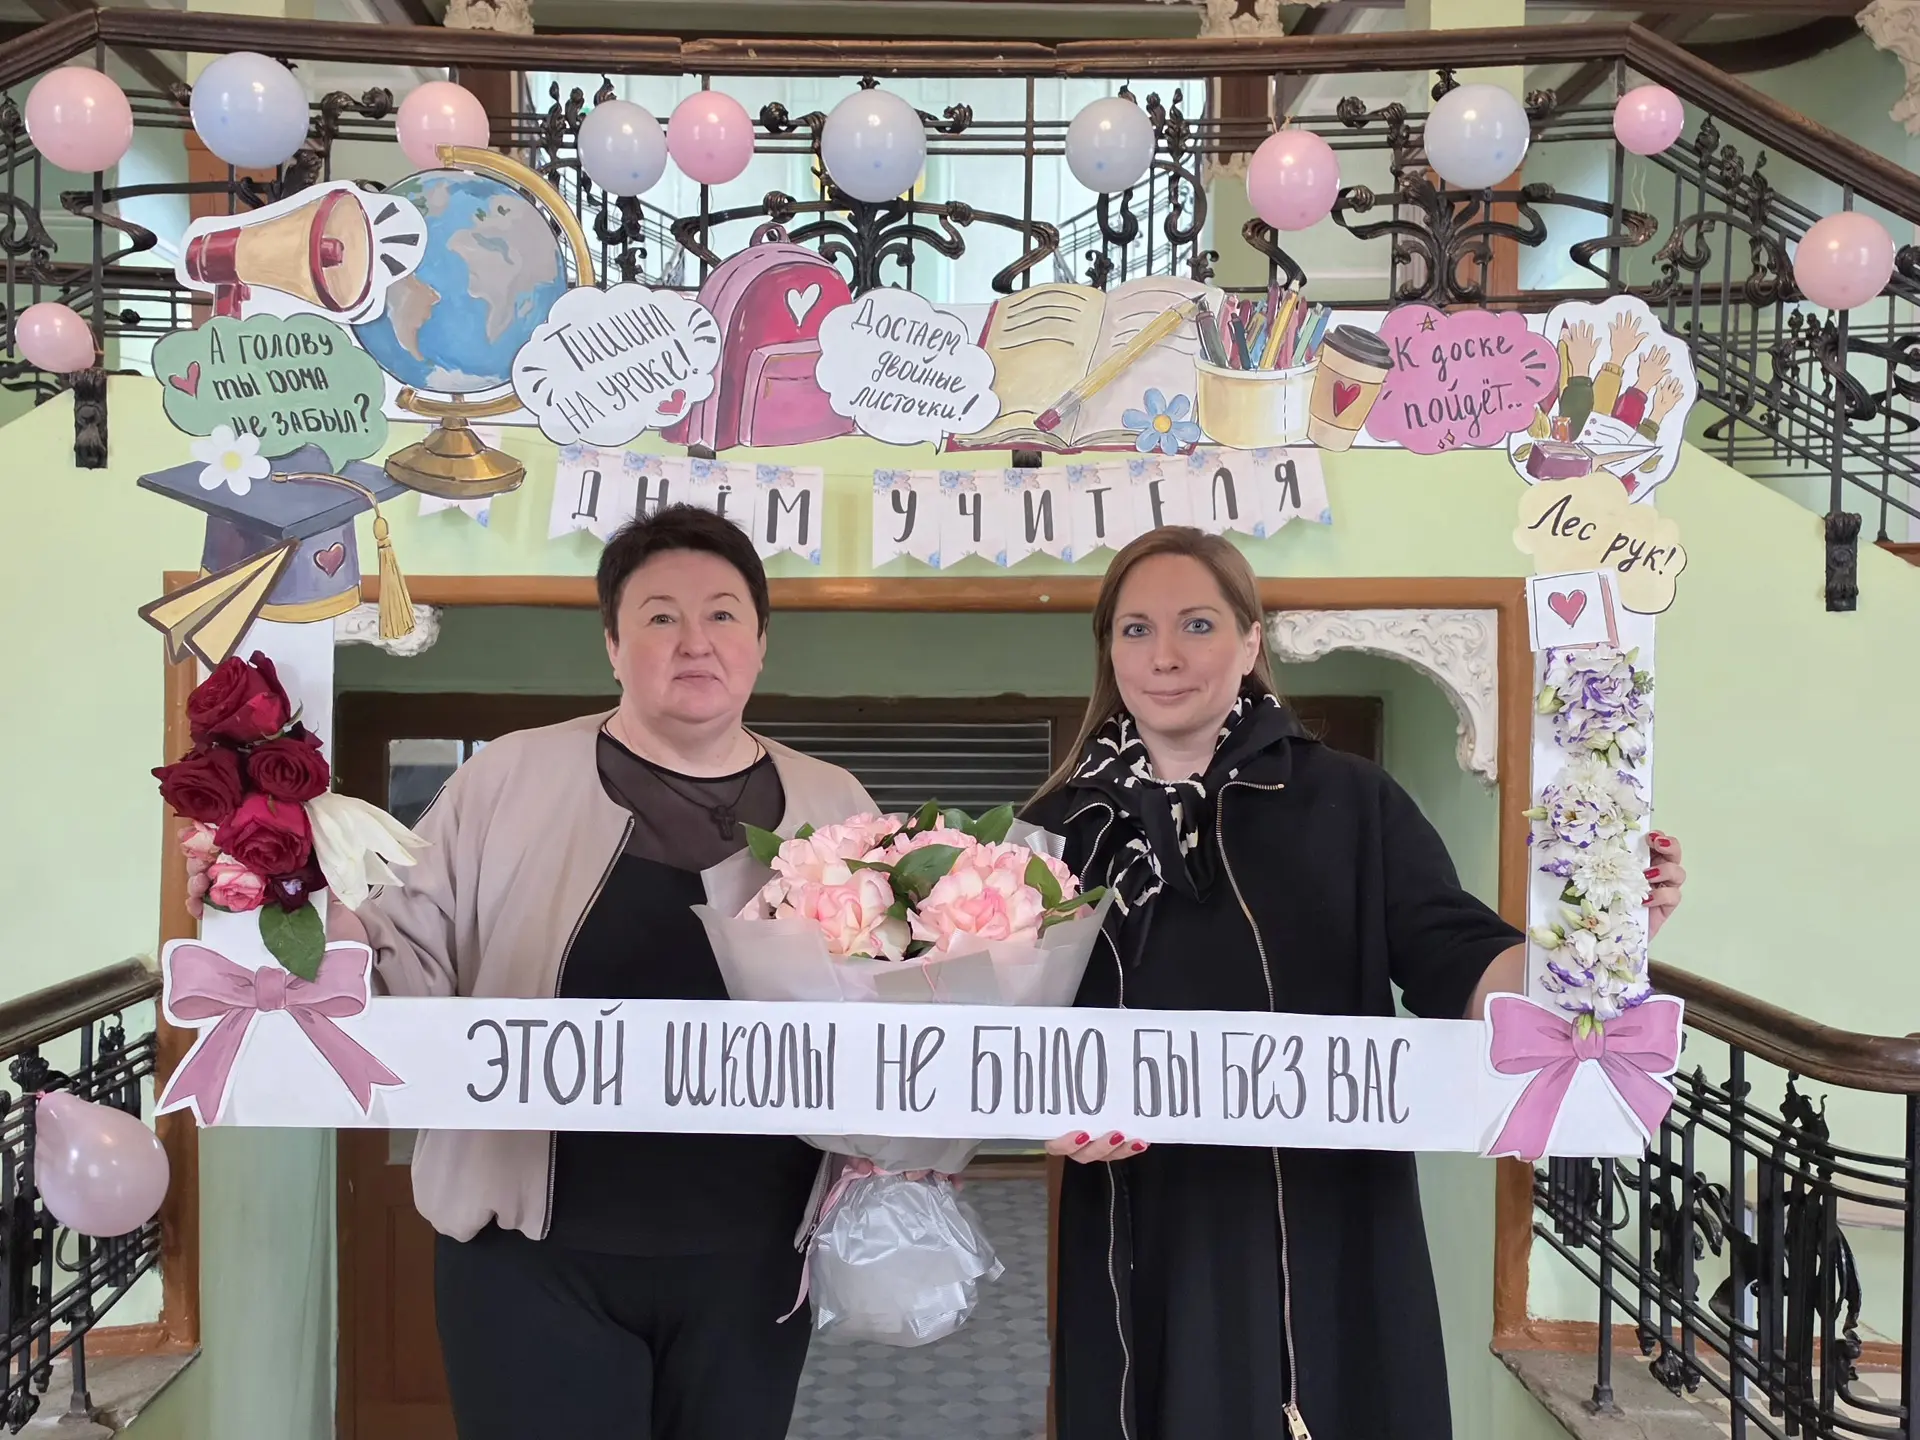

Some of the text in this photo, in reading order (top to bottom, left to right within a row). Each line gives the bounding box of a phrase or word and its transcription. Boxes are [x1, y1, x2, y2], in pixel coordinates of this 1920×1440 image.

[211, 327, 226, 365] А
[1394, 334, 1514, 382] К доске
[555, 390, 607, 435] НА
[890, 459, 1302, 545] УЧИТЕЛЯ
[1528, 494, 1677, 576] Лес рук!
[466, 1001, 624, 1106] ЭТОЙ
[663, 1019, 837, 1111] ШКОЛЫ
[970, 1025, 1109, 1115] БЫЛО
[1132, 1027, 1202, 1119] БЫ
[1326, 1035, 1412, 1125] ВАС
